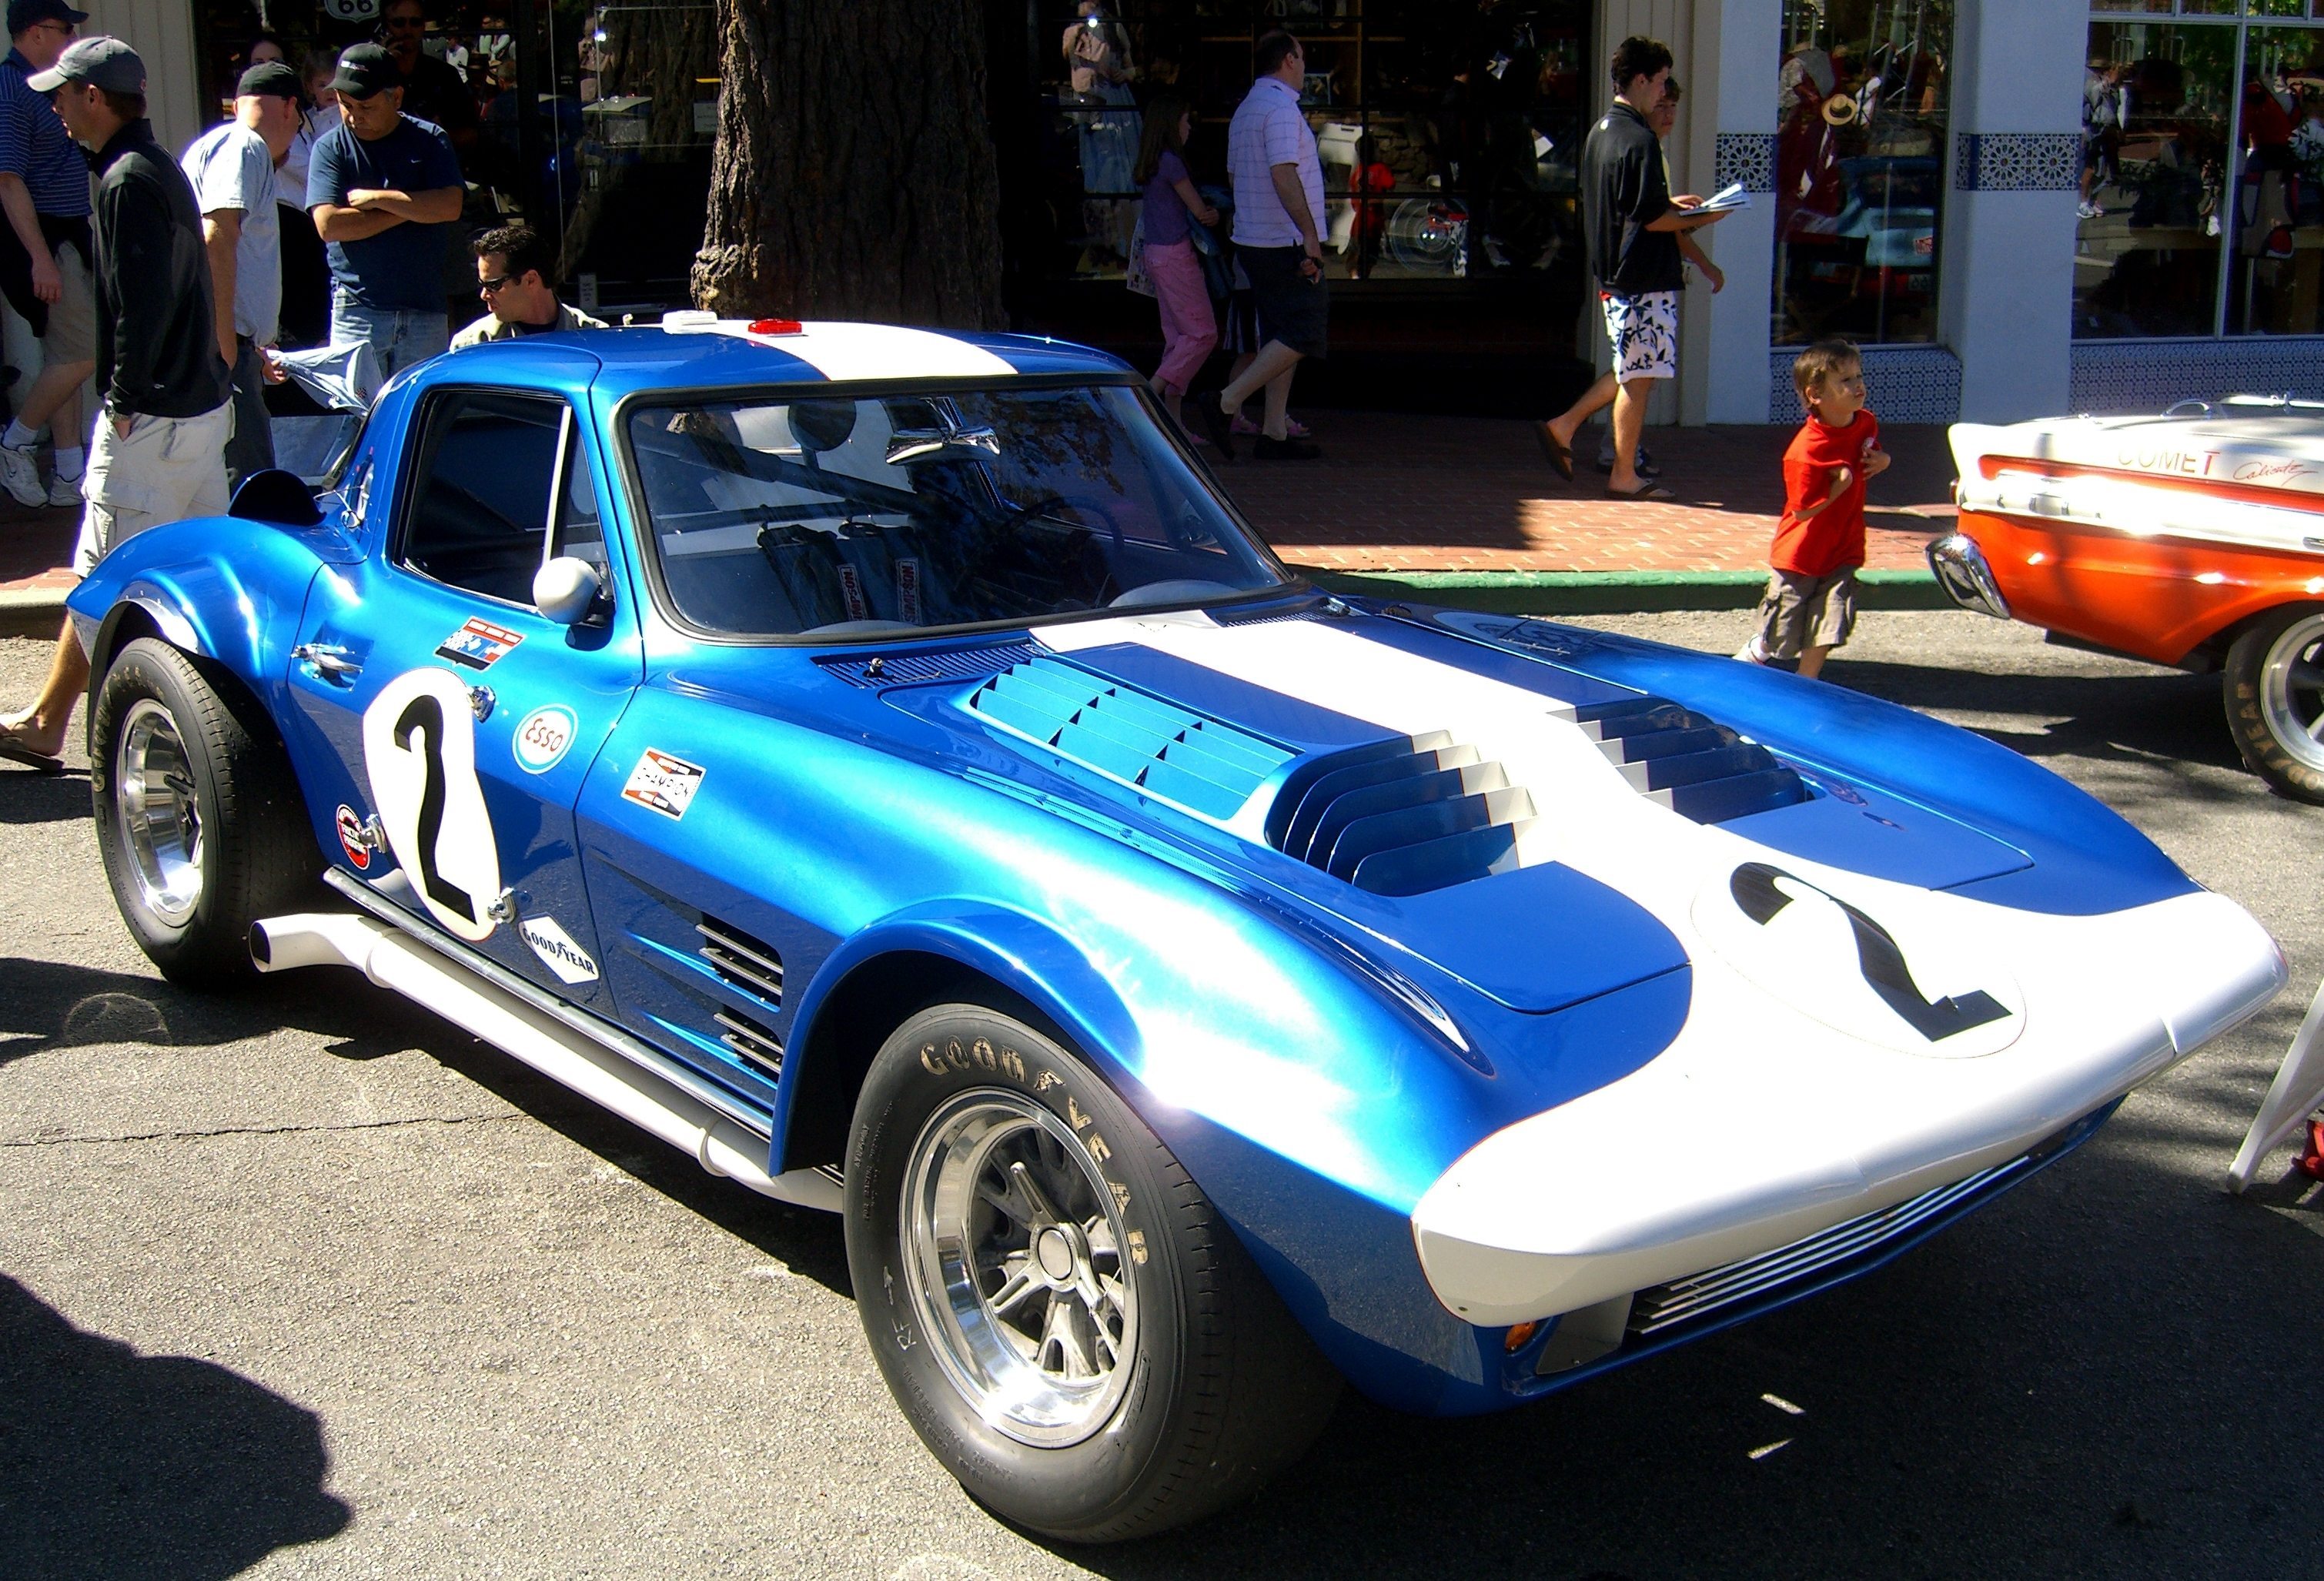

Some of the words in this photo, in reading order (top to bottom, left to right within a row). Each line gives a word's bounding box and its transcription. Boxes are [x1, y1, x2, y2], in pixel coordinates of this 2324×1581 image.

[338, 0, 373, 14] 66
[2118, 448, 2221, 476] COMET
[394, 694, 477, 925] 2
[1730, 862, 2013, 1042] 2
